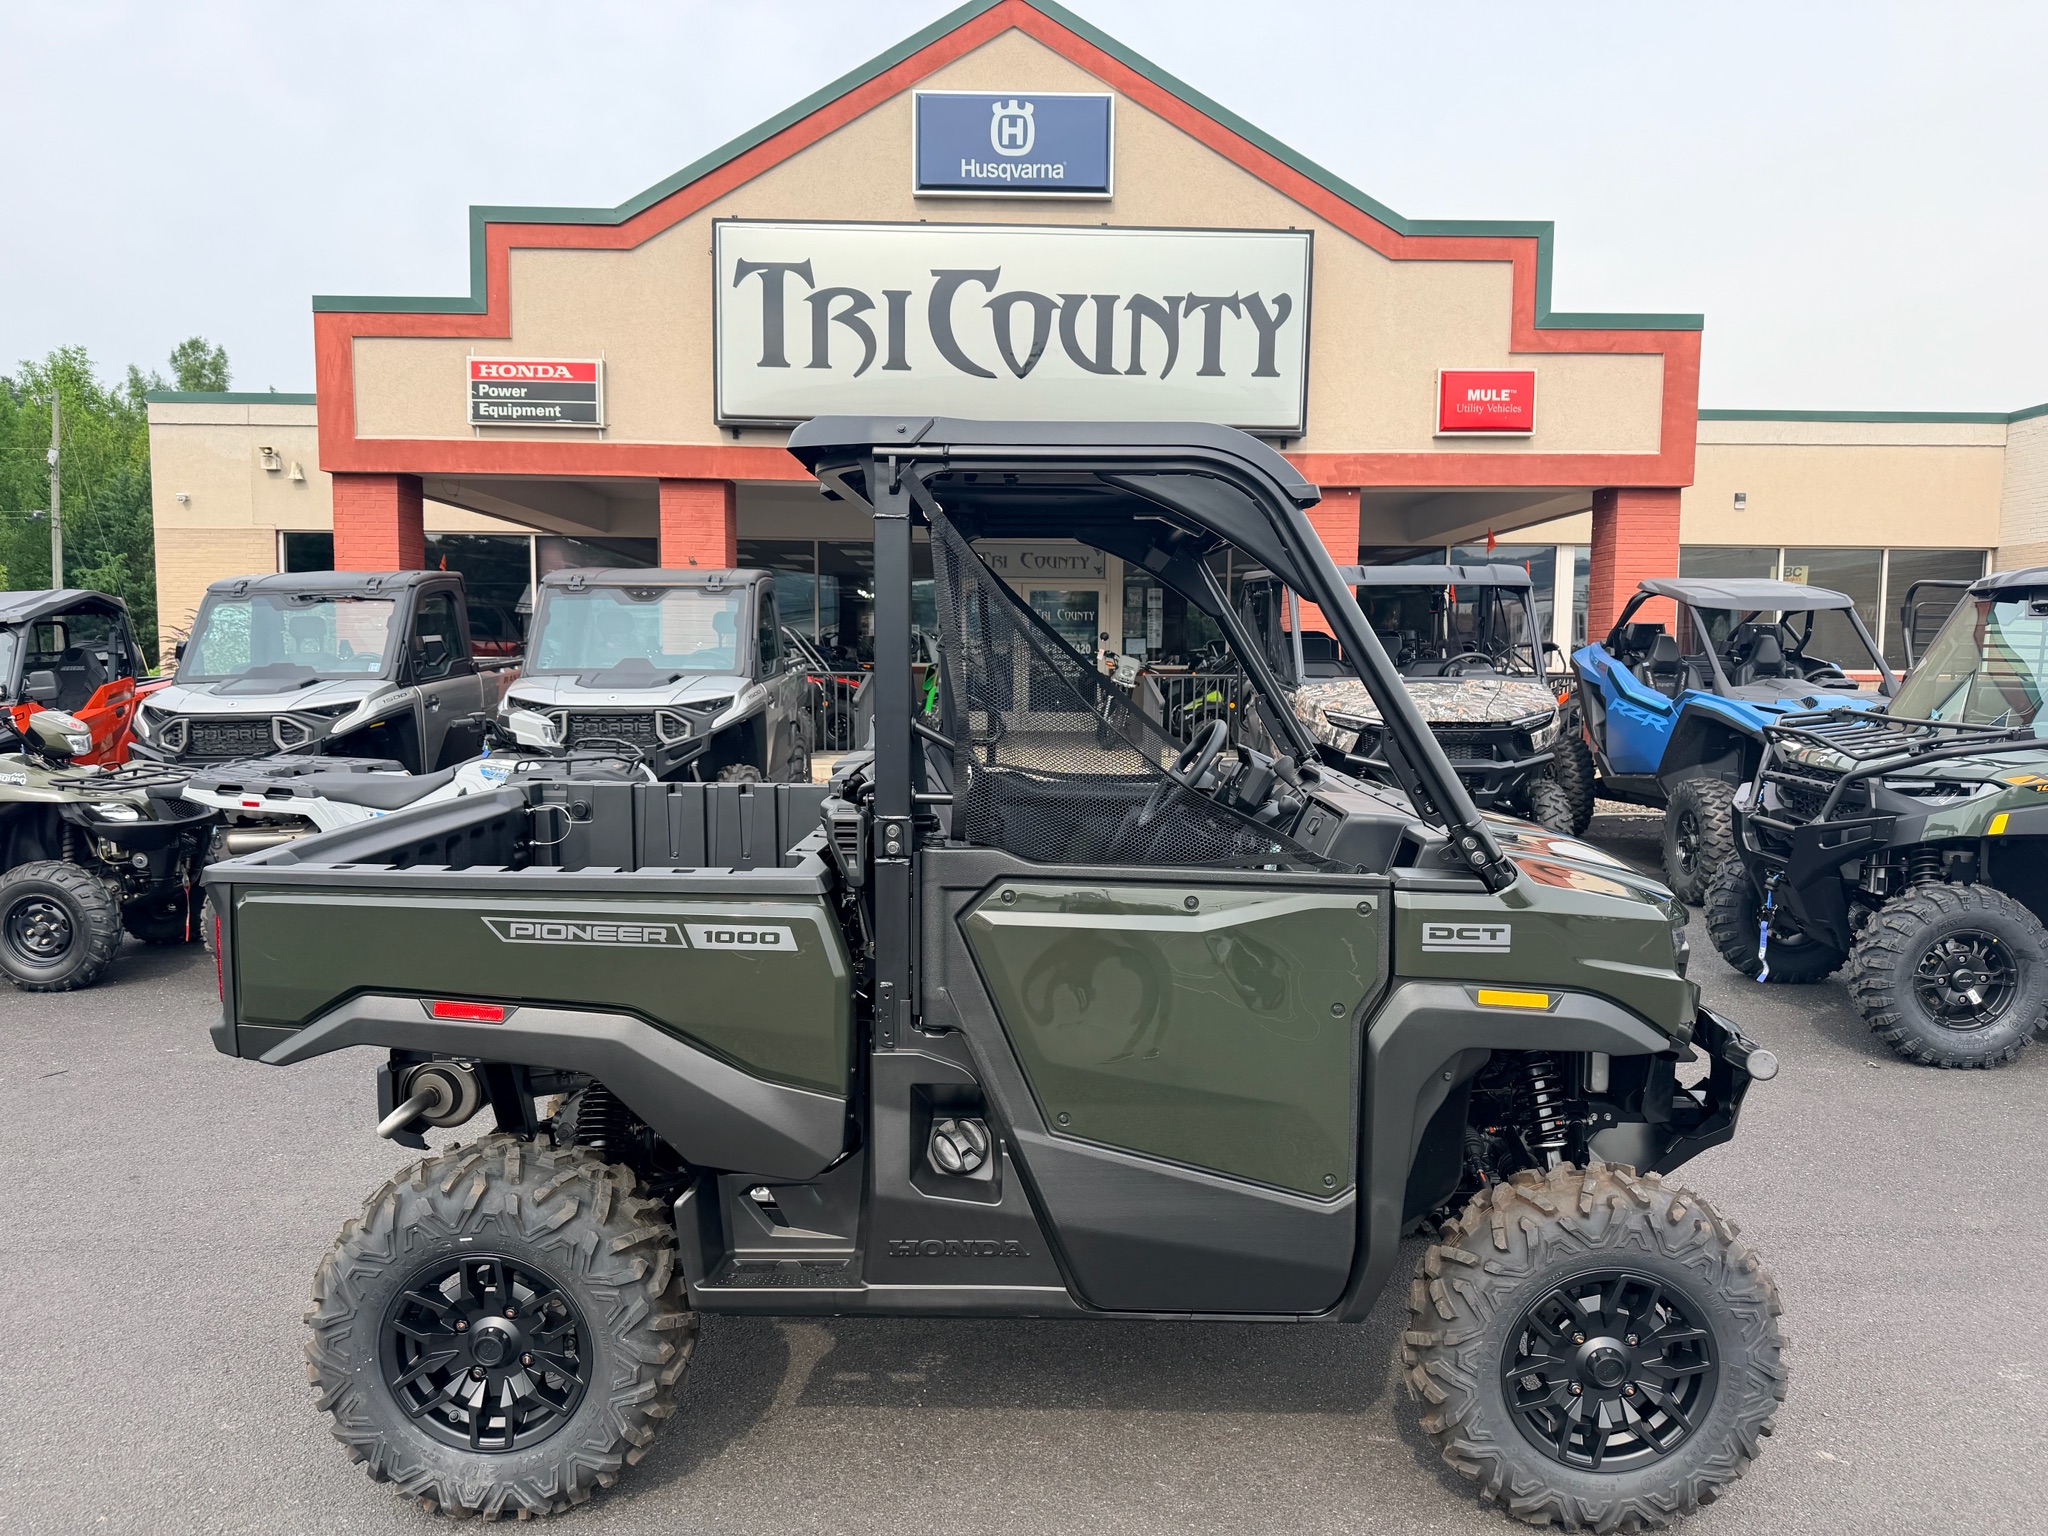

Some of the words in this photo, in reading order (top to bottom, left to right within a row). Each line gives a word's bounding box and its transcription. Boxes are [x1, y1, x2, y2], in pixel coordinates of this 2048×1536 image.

[961, 158, 1065, 182] Husqvarna
[478, 364, 573, 379] HONDA
[478, 384, 528, 398] Power
[479, 402, 562, 419] Equipment
[1456, 403, 1485, 415] Utility
[1486, 403, 1522, 414] Vehicles
[1783, 567, 1803, 577] BC
[382, 692, 408, 704] 1500
[1607, 697, 1670, 734] RZR
[191, 728, 270, 741] POLARIS
[573, 721, 652, 735] POLARIS
[509, 922, 668, 943] PIONEER
[703, 929, 781, 945] 1000
[1428, 926, 1506, 941] DCT
[888, 1238, 1031, 1259] HONDA
